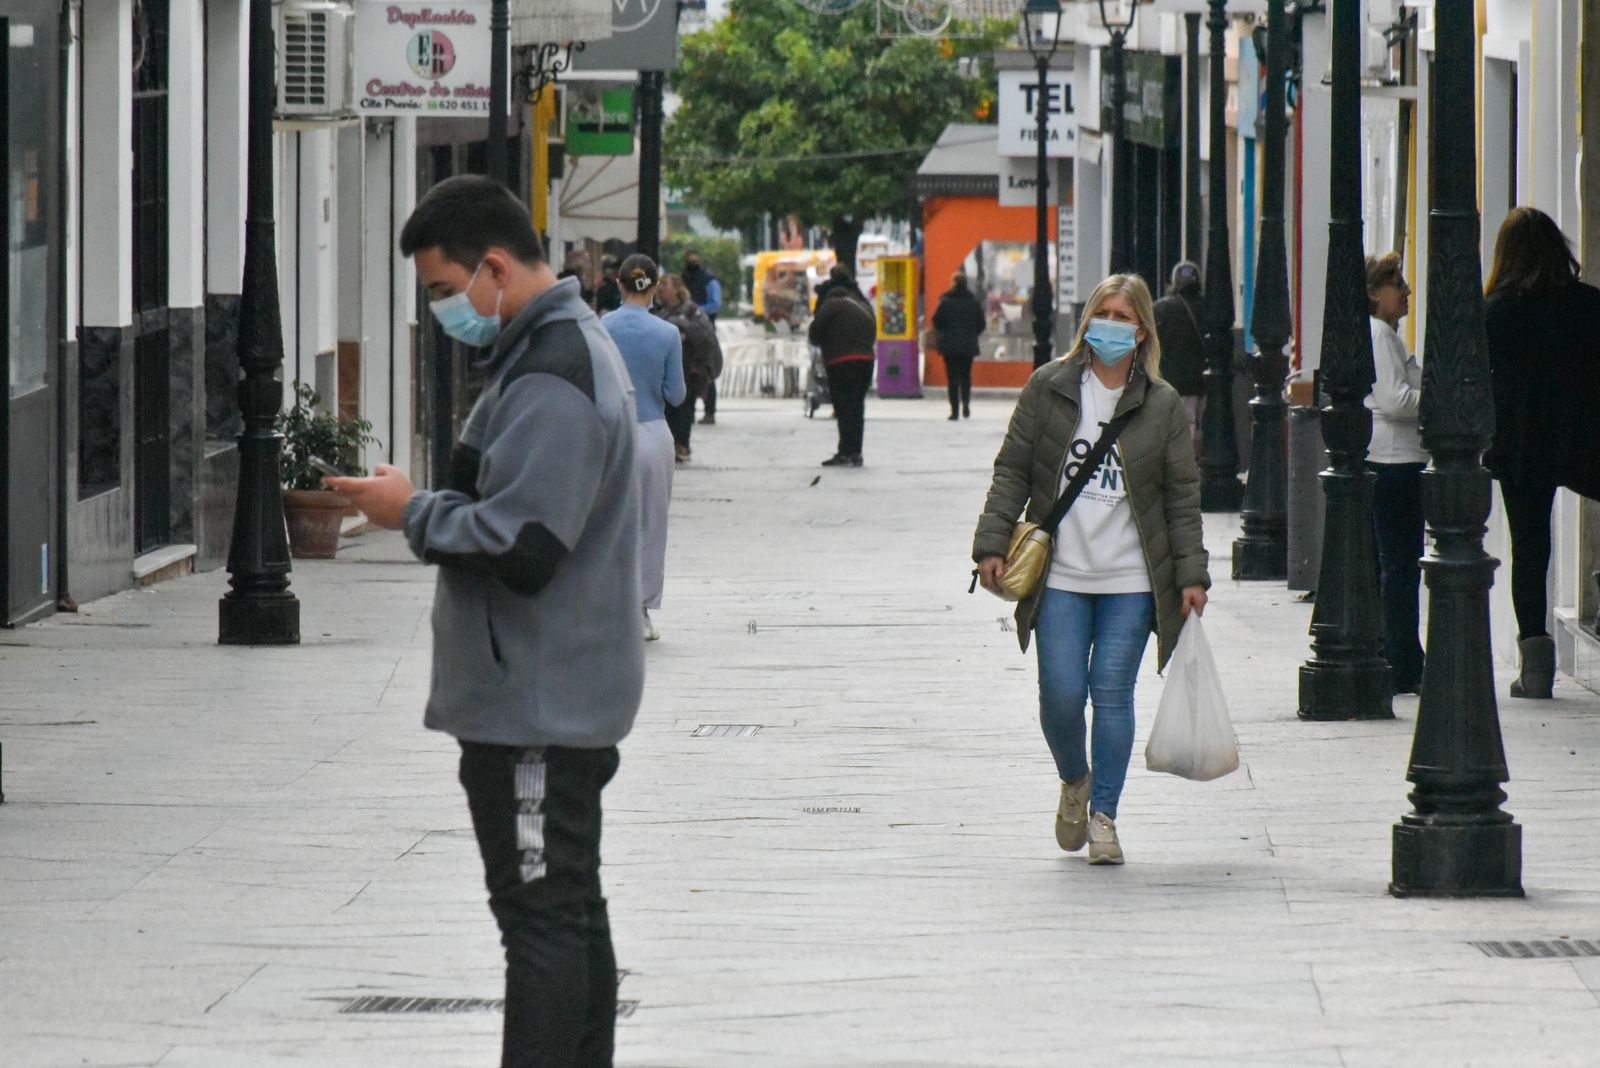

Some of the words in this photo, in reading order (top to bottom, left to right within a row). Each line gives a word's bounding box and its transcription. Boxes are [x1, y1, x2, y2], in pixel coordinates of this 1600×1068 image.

[386, 5, 476, 29] Depilación
[366, 78, 426, 97] Centro
[429, 81, 450, 97] de
[360, 98, 382, 109] Cita
[439, 100, 458, 110] 620
[460, 100, 478, 110] 451
